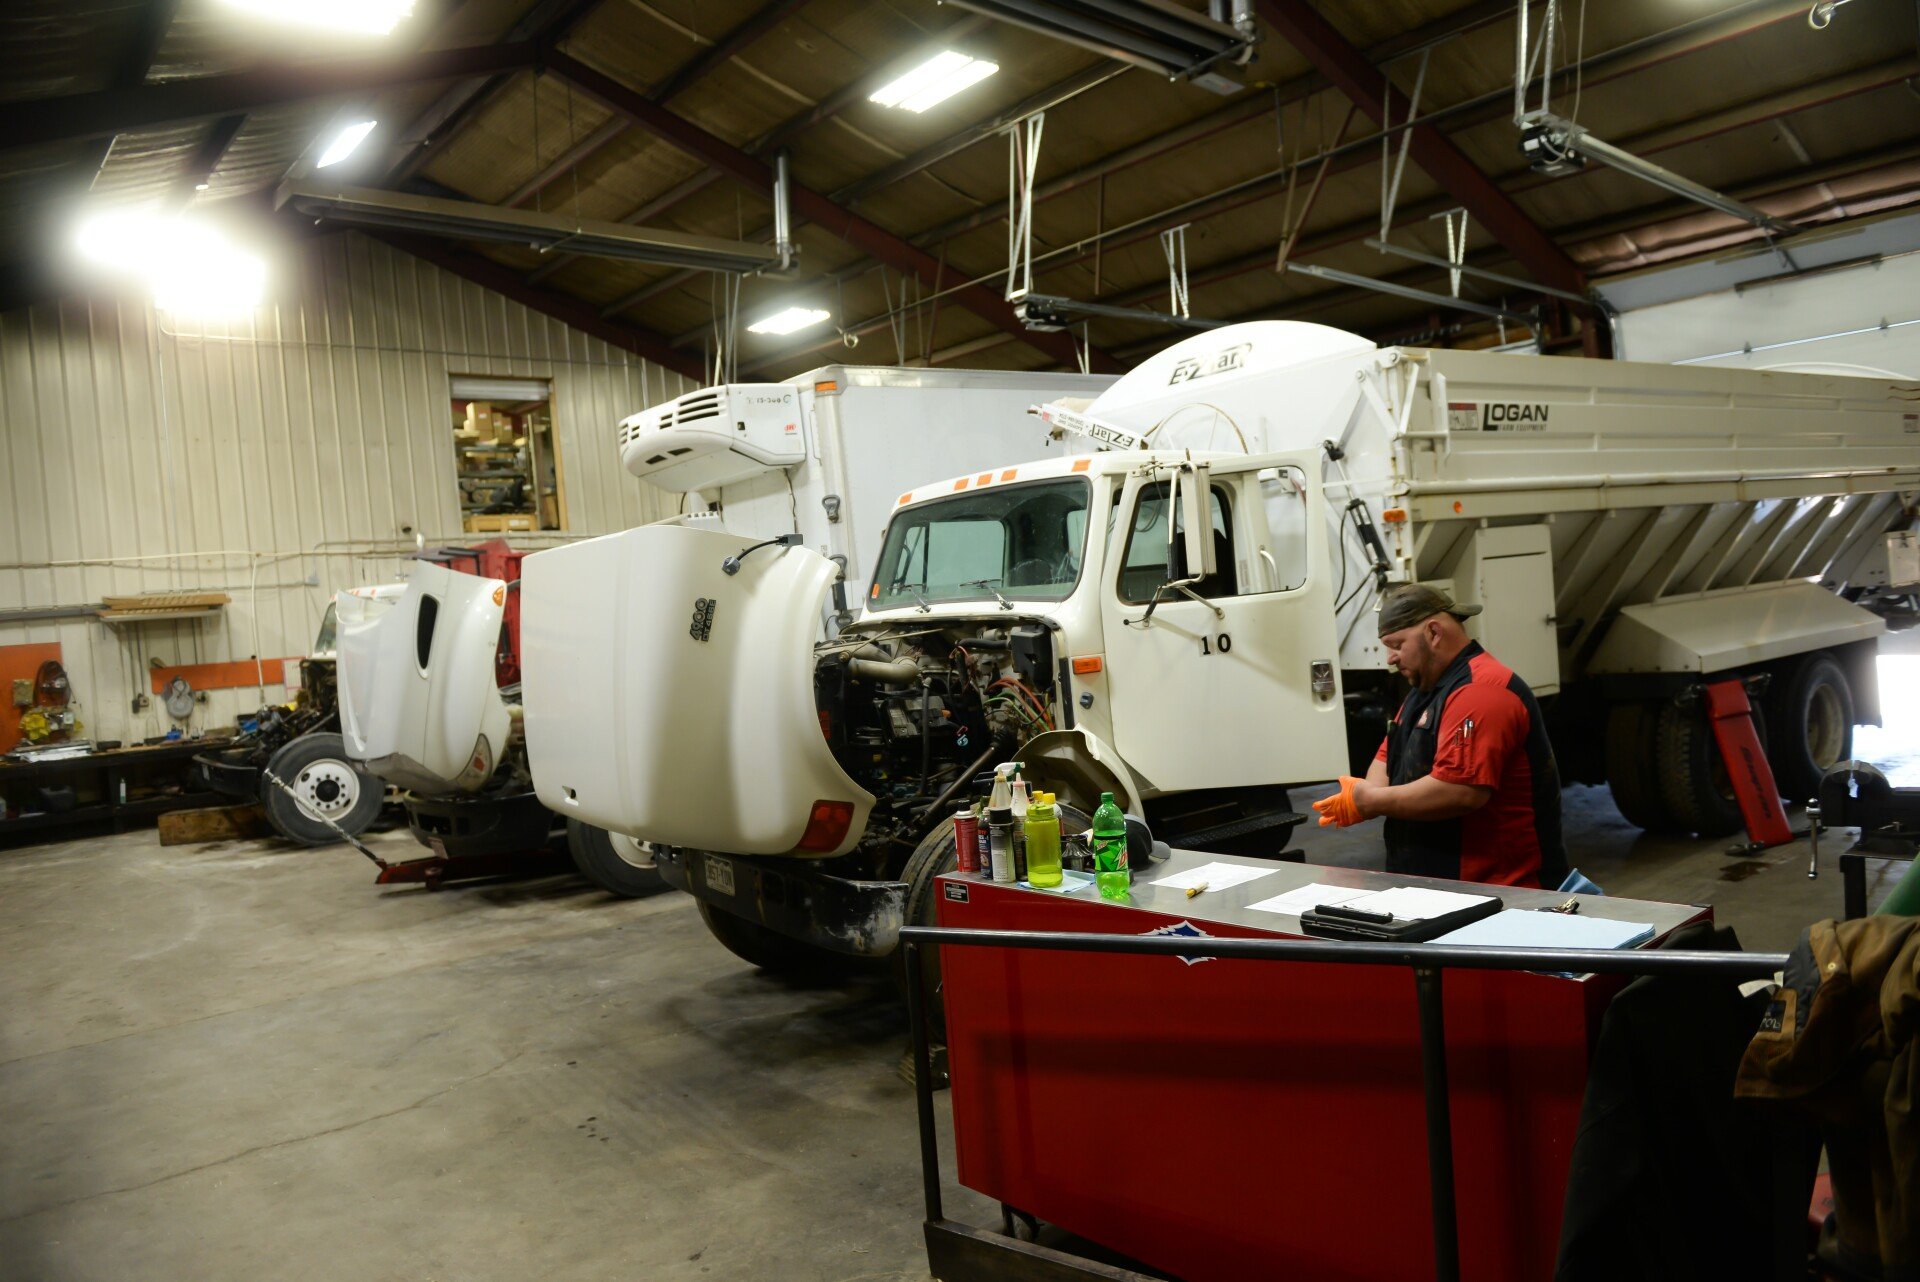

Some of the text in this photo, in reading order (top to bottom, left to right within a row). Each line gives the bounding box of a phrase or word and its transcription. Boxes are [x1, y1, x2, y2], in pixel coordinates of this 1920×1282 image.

[1483, 403, 1549, 431] LOGAN
[690, 598, 708, 640] 4900
[1201, 633, 1232, 655] 10
